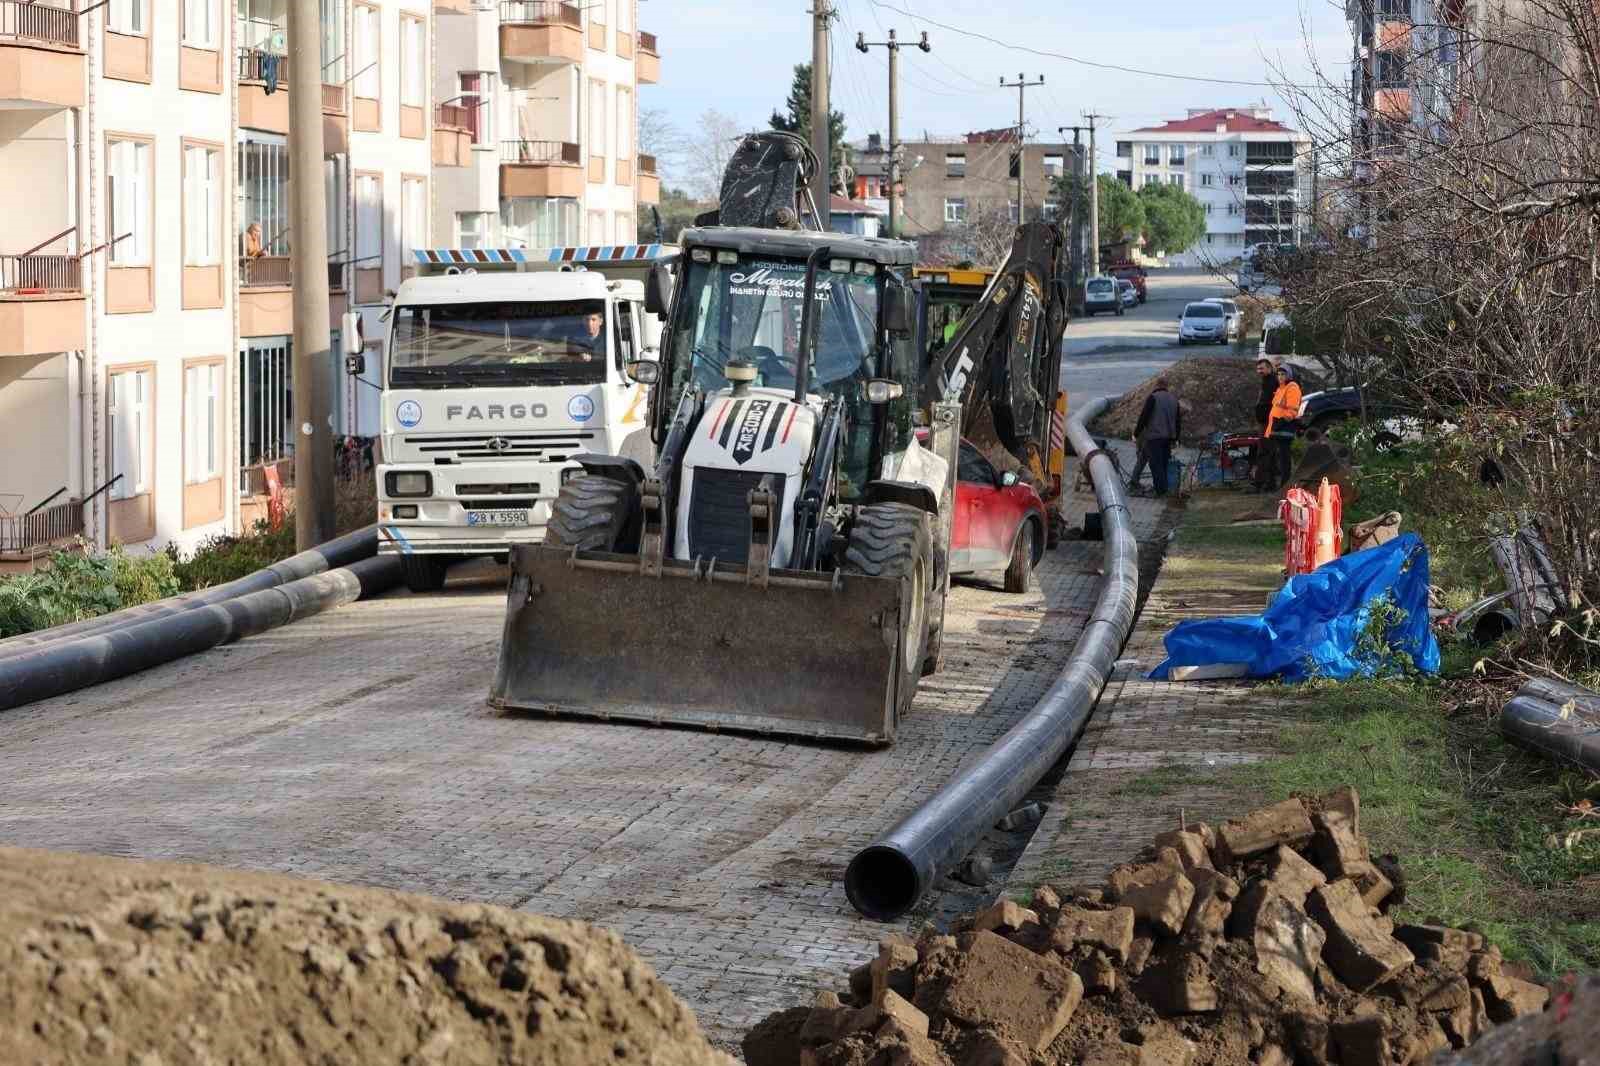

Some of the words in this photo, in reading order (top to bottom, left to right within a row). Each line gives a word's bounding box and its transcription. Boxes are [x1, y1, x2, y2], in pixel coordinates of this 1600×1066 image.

[446, 403, 548, 420] FARGO
[474, 511, 488, 523] 28
[500, 512, 526, 523] 5590
